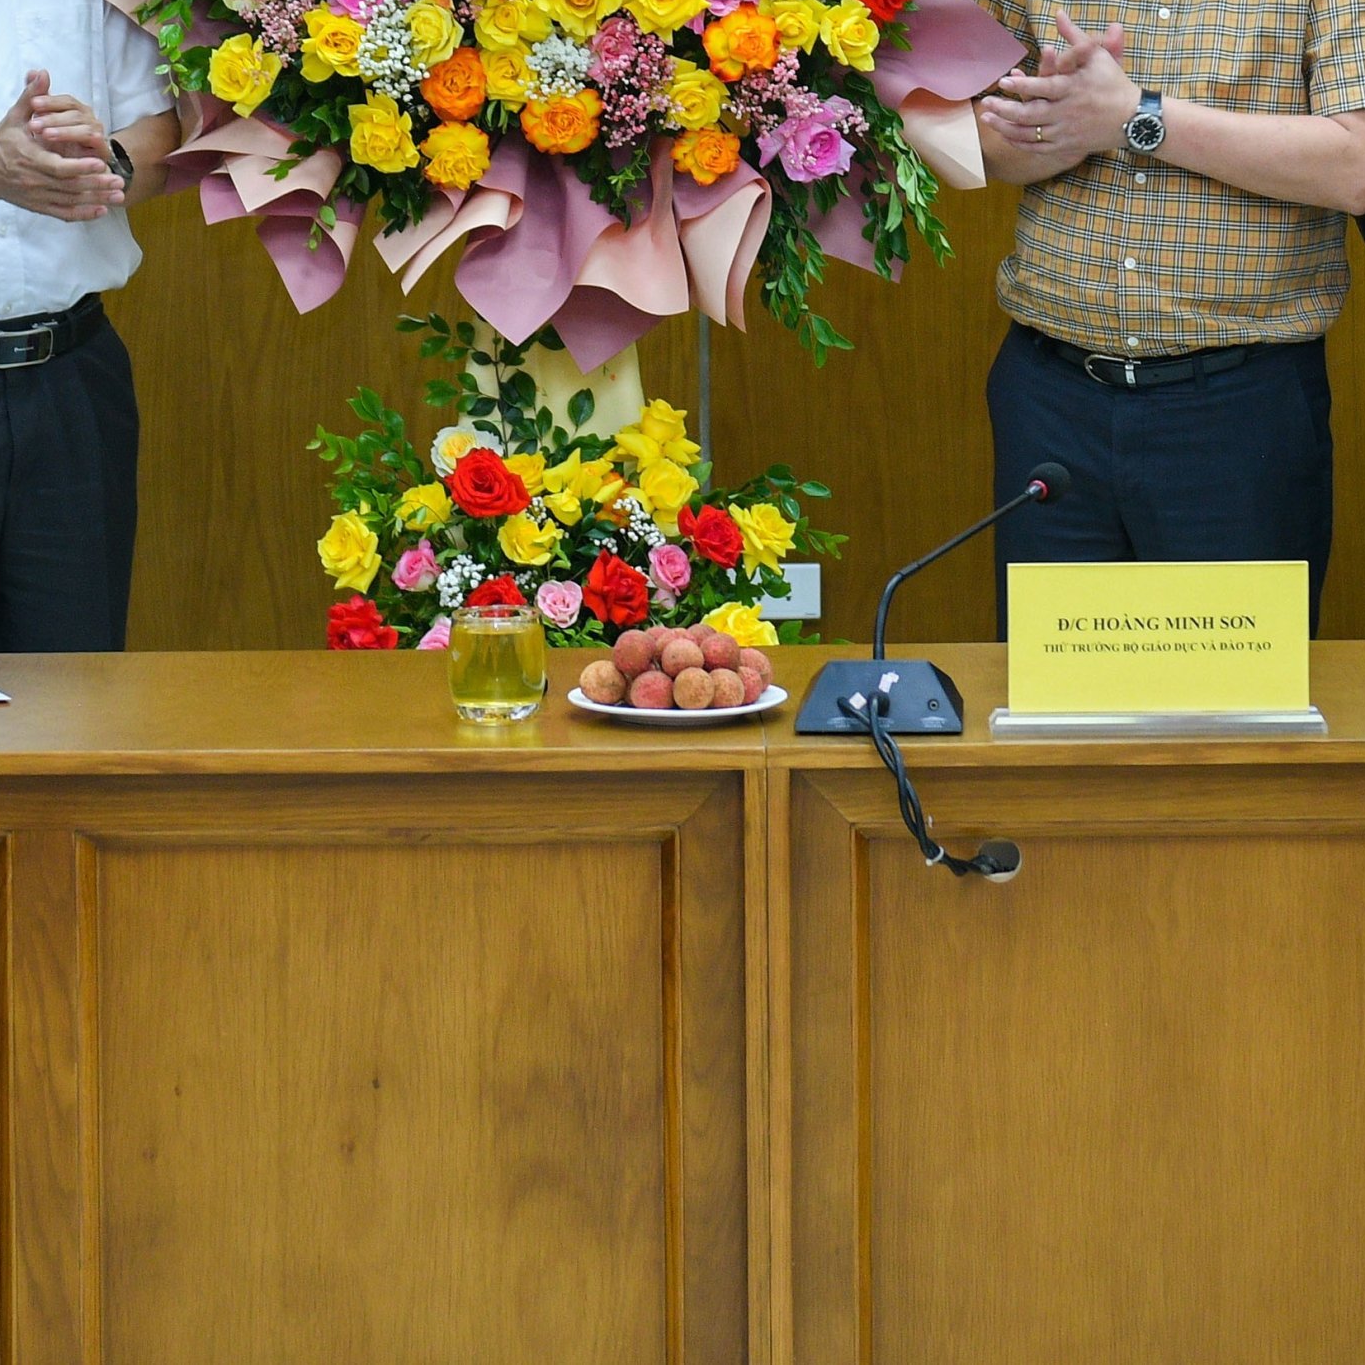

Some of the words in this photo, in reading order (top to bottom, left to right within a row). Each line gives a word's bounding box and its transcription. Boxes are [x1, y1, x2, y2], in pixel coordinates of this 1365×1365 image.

[1057, 616, 1088, 632] Đ/C
[1093, 613, 1159, 631] HOÀNG
[1165, 616, 1214, 630] MINH
[1220, 615, 1256, 630] SƠN
[1142, 640, 1172, 652] GIÁO
[1174, 641, 1198, 653] DỤC
[1201, 639, 1217, 652] VÀ
